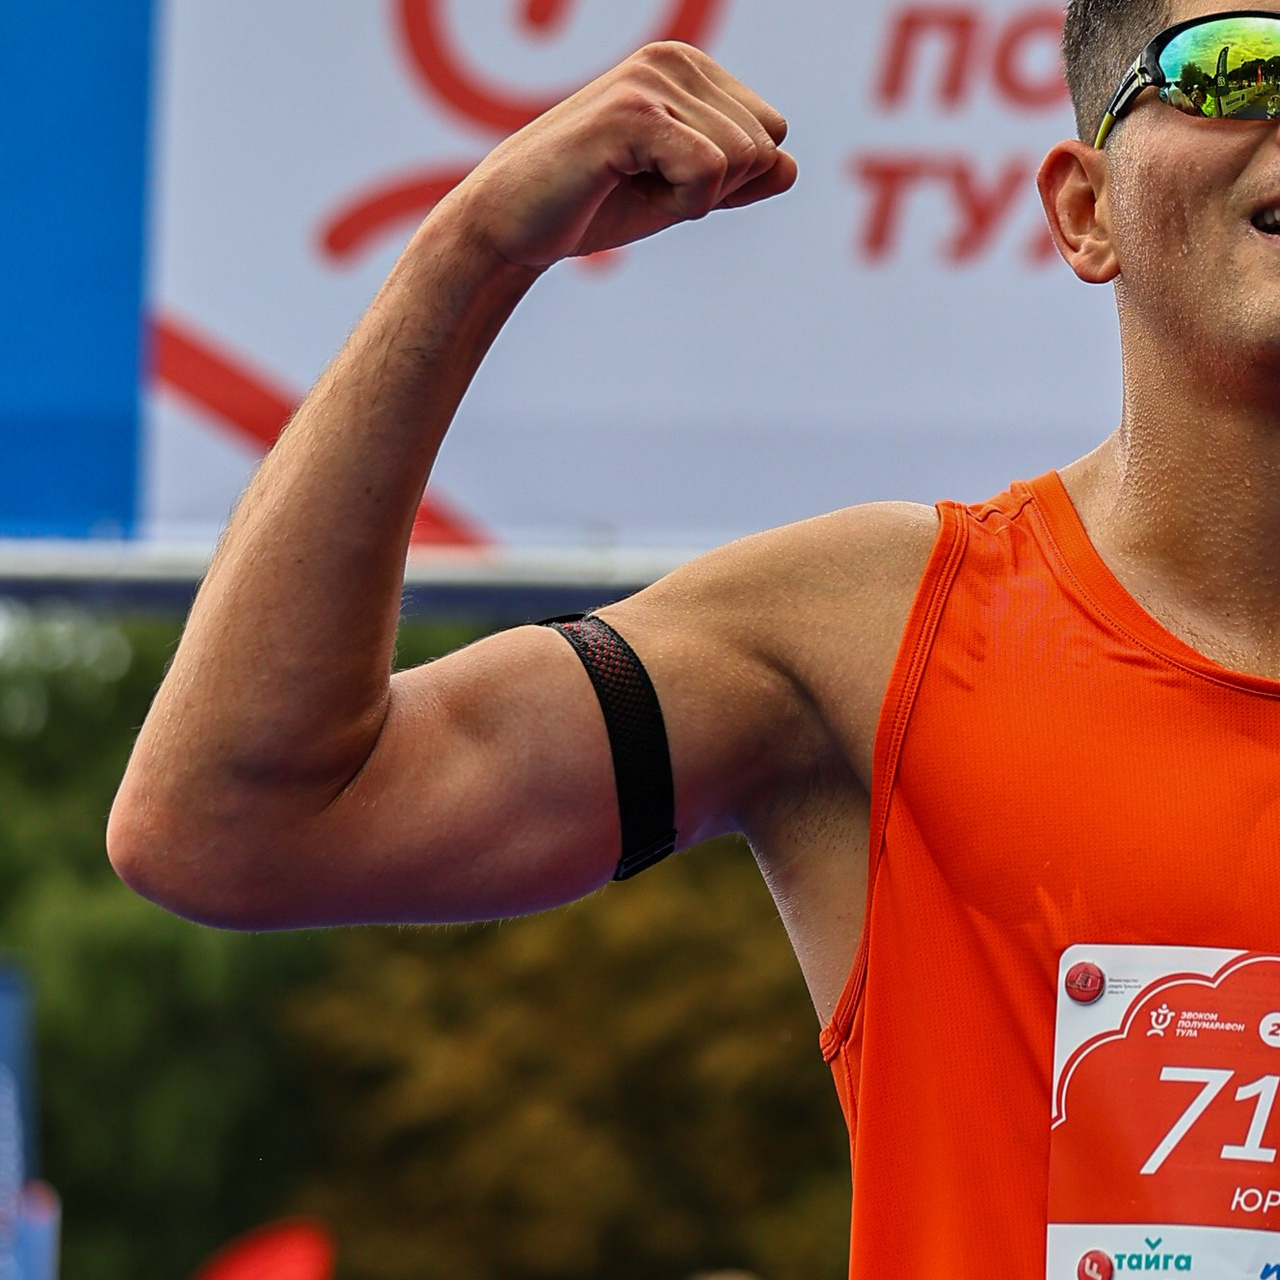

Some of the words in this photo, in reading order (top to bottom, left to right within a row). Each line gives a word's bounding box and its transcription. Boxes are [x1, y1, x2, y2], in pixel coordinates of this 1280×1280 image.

[1180, 1011, 1218, 1021] ЭВОКОМ
[1177, 1019, 1245, 1032] ПОЛУМАРАФОН
[1175, 1027, 1198, 1037] ТУЛА
[1114, 1236, 1192, 1270] тайга
